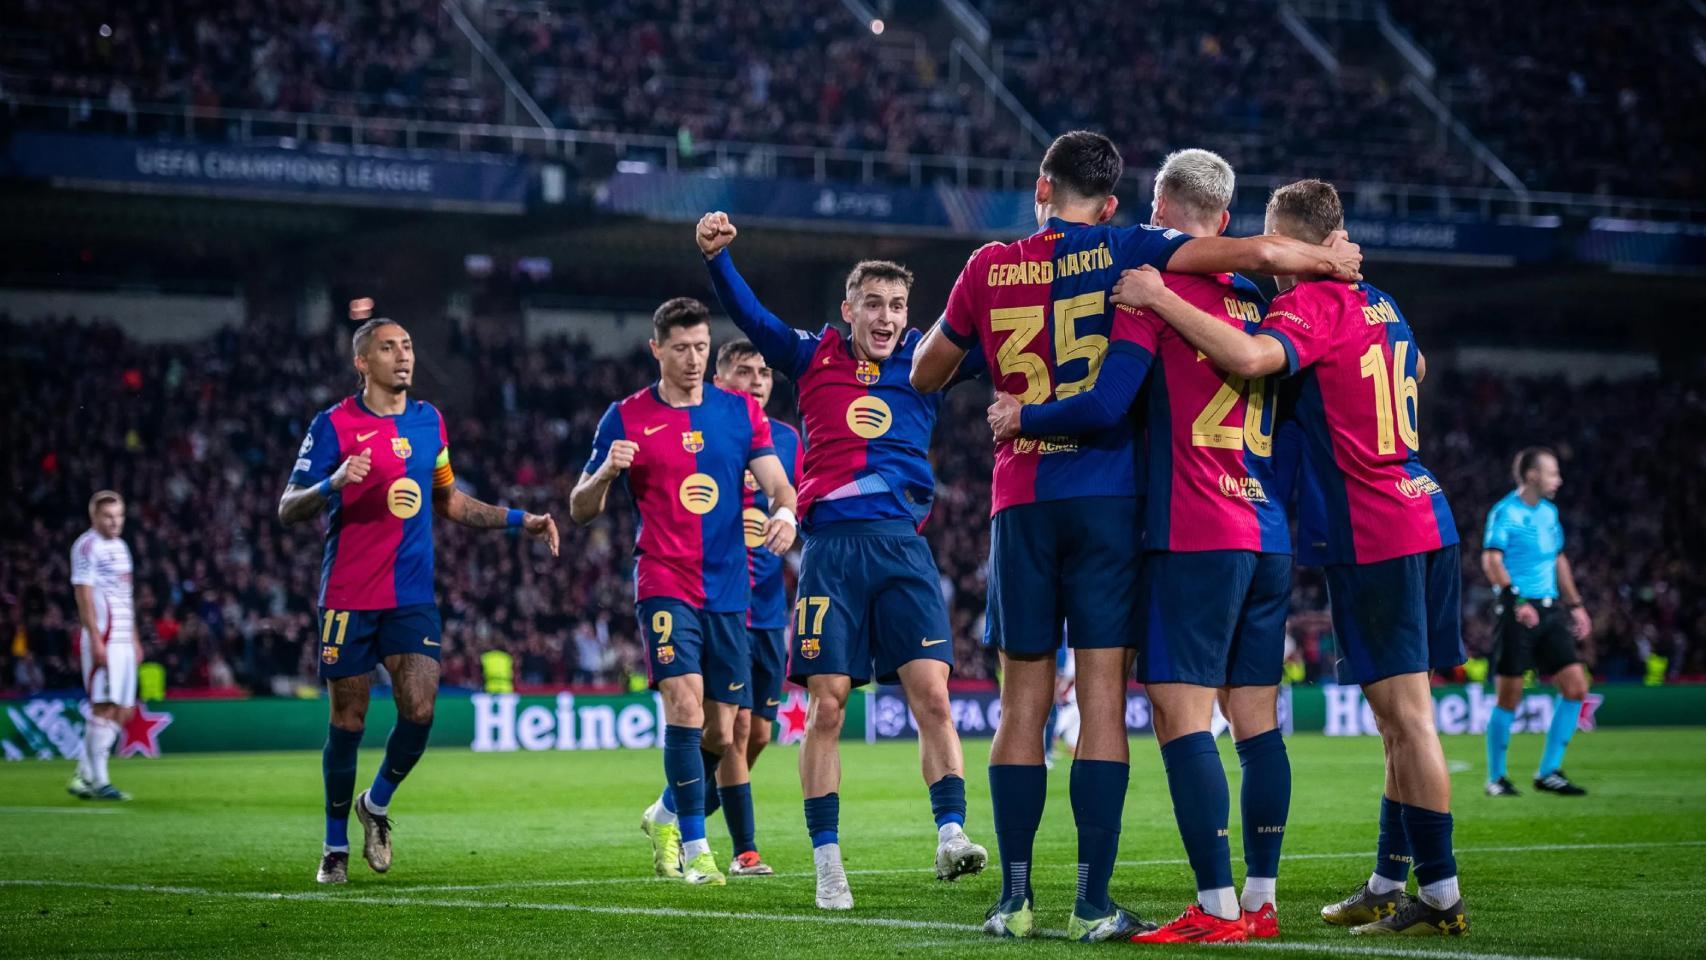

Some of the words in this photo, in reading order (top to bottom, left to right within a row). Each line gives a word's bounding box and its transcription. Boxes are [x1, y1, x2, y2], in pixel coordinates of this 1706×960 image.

[136, 146, 200, 178] UEFA
[205, 151, 341, 187] CHAMPIONS
[345, 158, 431, 192] LEAGUE
[987, 261, 1053, 286] GERARD
[1056, 242, 1113, 278] MARTÍN
[1224, 296, 1261, 323] OLMO
[1264, 310, 1303, 326] AMBILIGHT
[1302, 322, 1312, 330] TV
[990, 291, 1108, 405] 35
[1360, 340, 1419, 456] 16
[322, 609, 349, 644] 11
[652, 610, 673, 644] 9
[796, 597, 830, 635] 17
[471, 691, 666, 752] Heine
[1324, 683, 1556, 736] Heken
